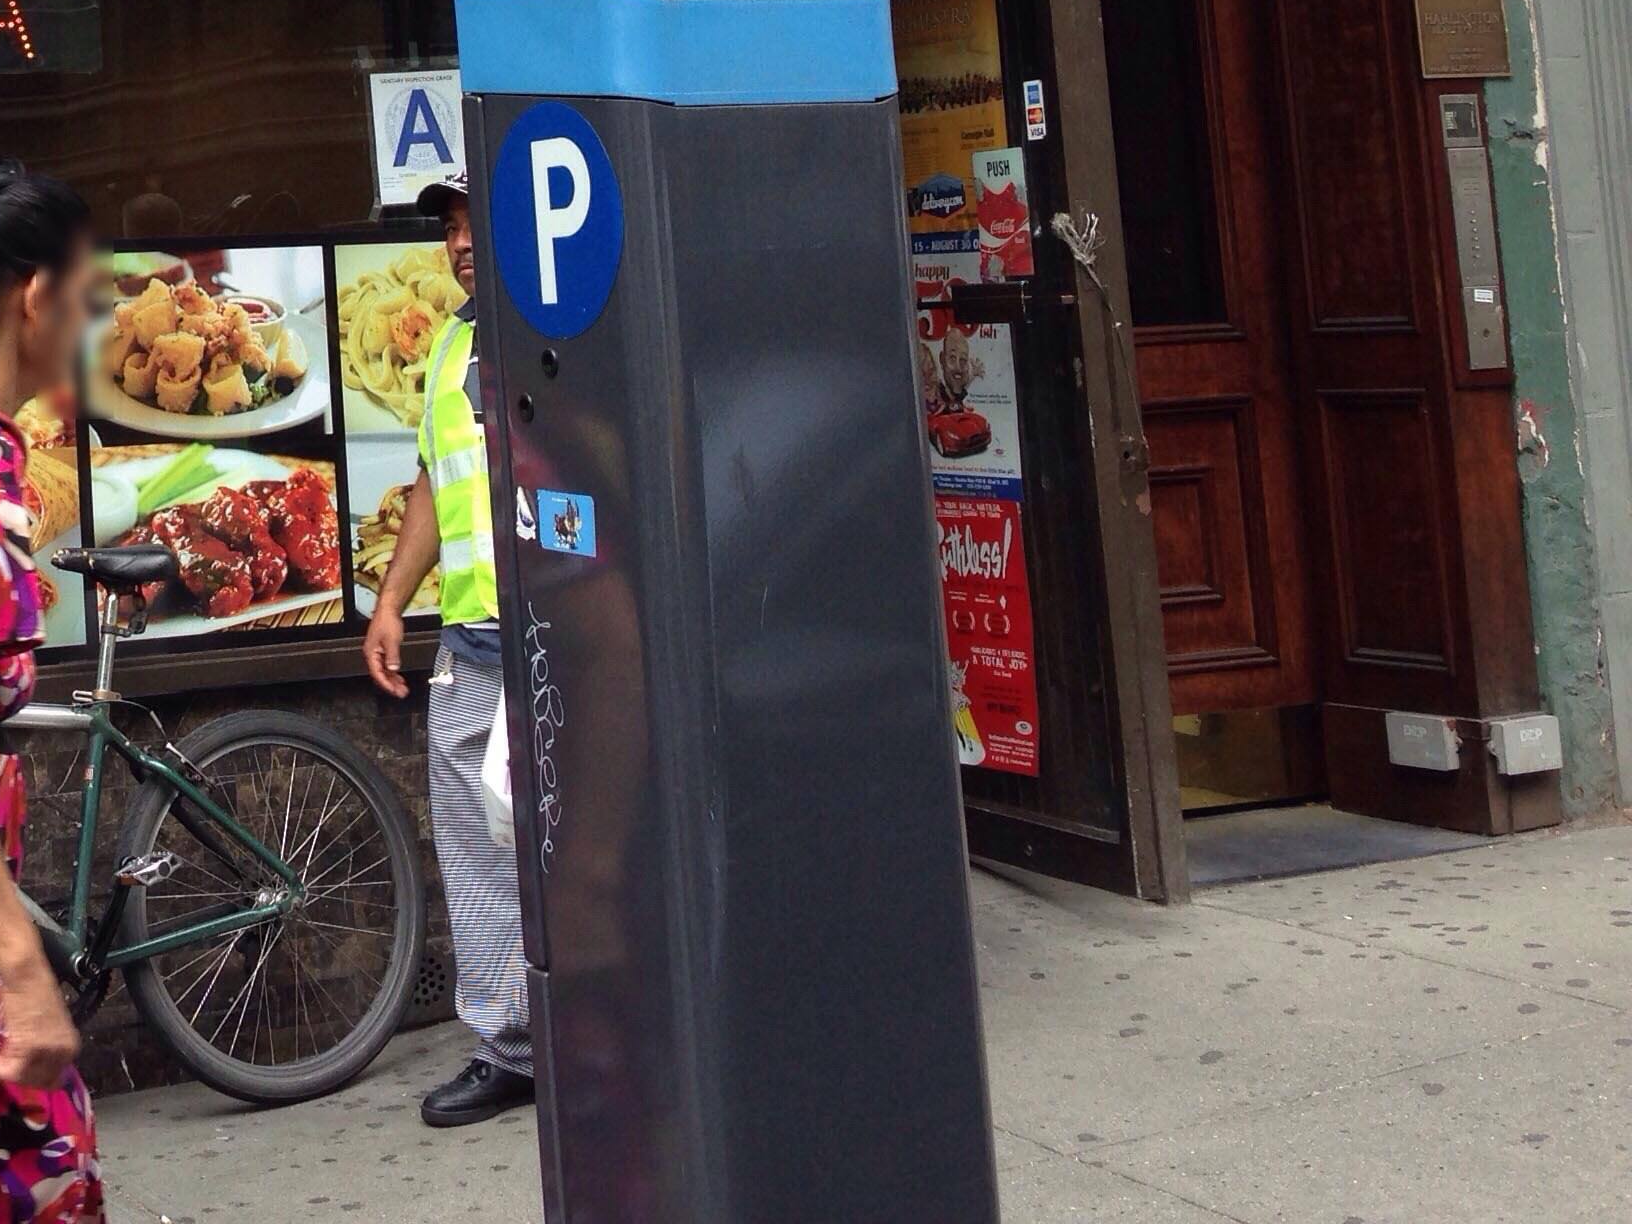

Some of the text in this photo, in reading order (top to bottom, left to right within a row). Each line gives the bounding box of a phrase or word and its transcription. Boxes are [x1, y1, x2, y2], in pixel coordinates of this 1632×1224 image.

[393, 89, 455, 167] A
[986, 160, 1011, 177] PUSH
[531, 137, 591, 305] P
[915, 263, 950, 280] happy
